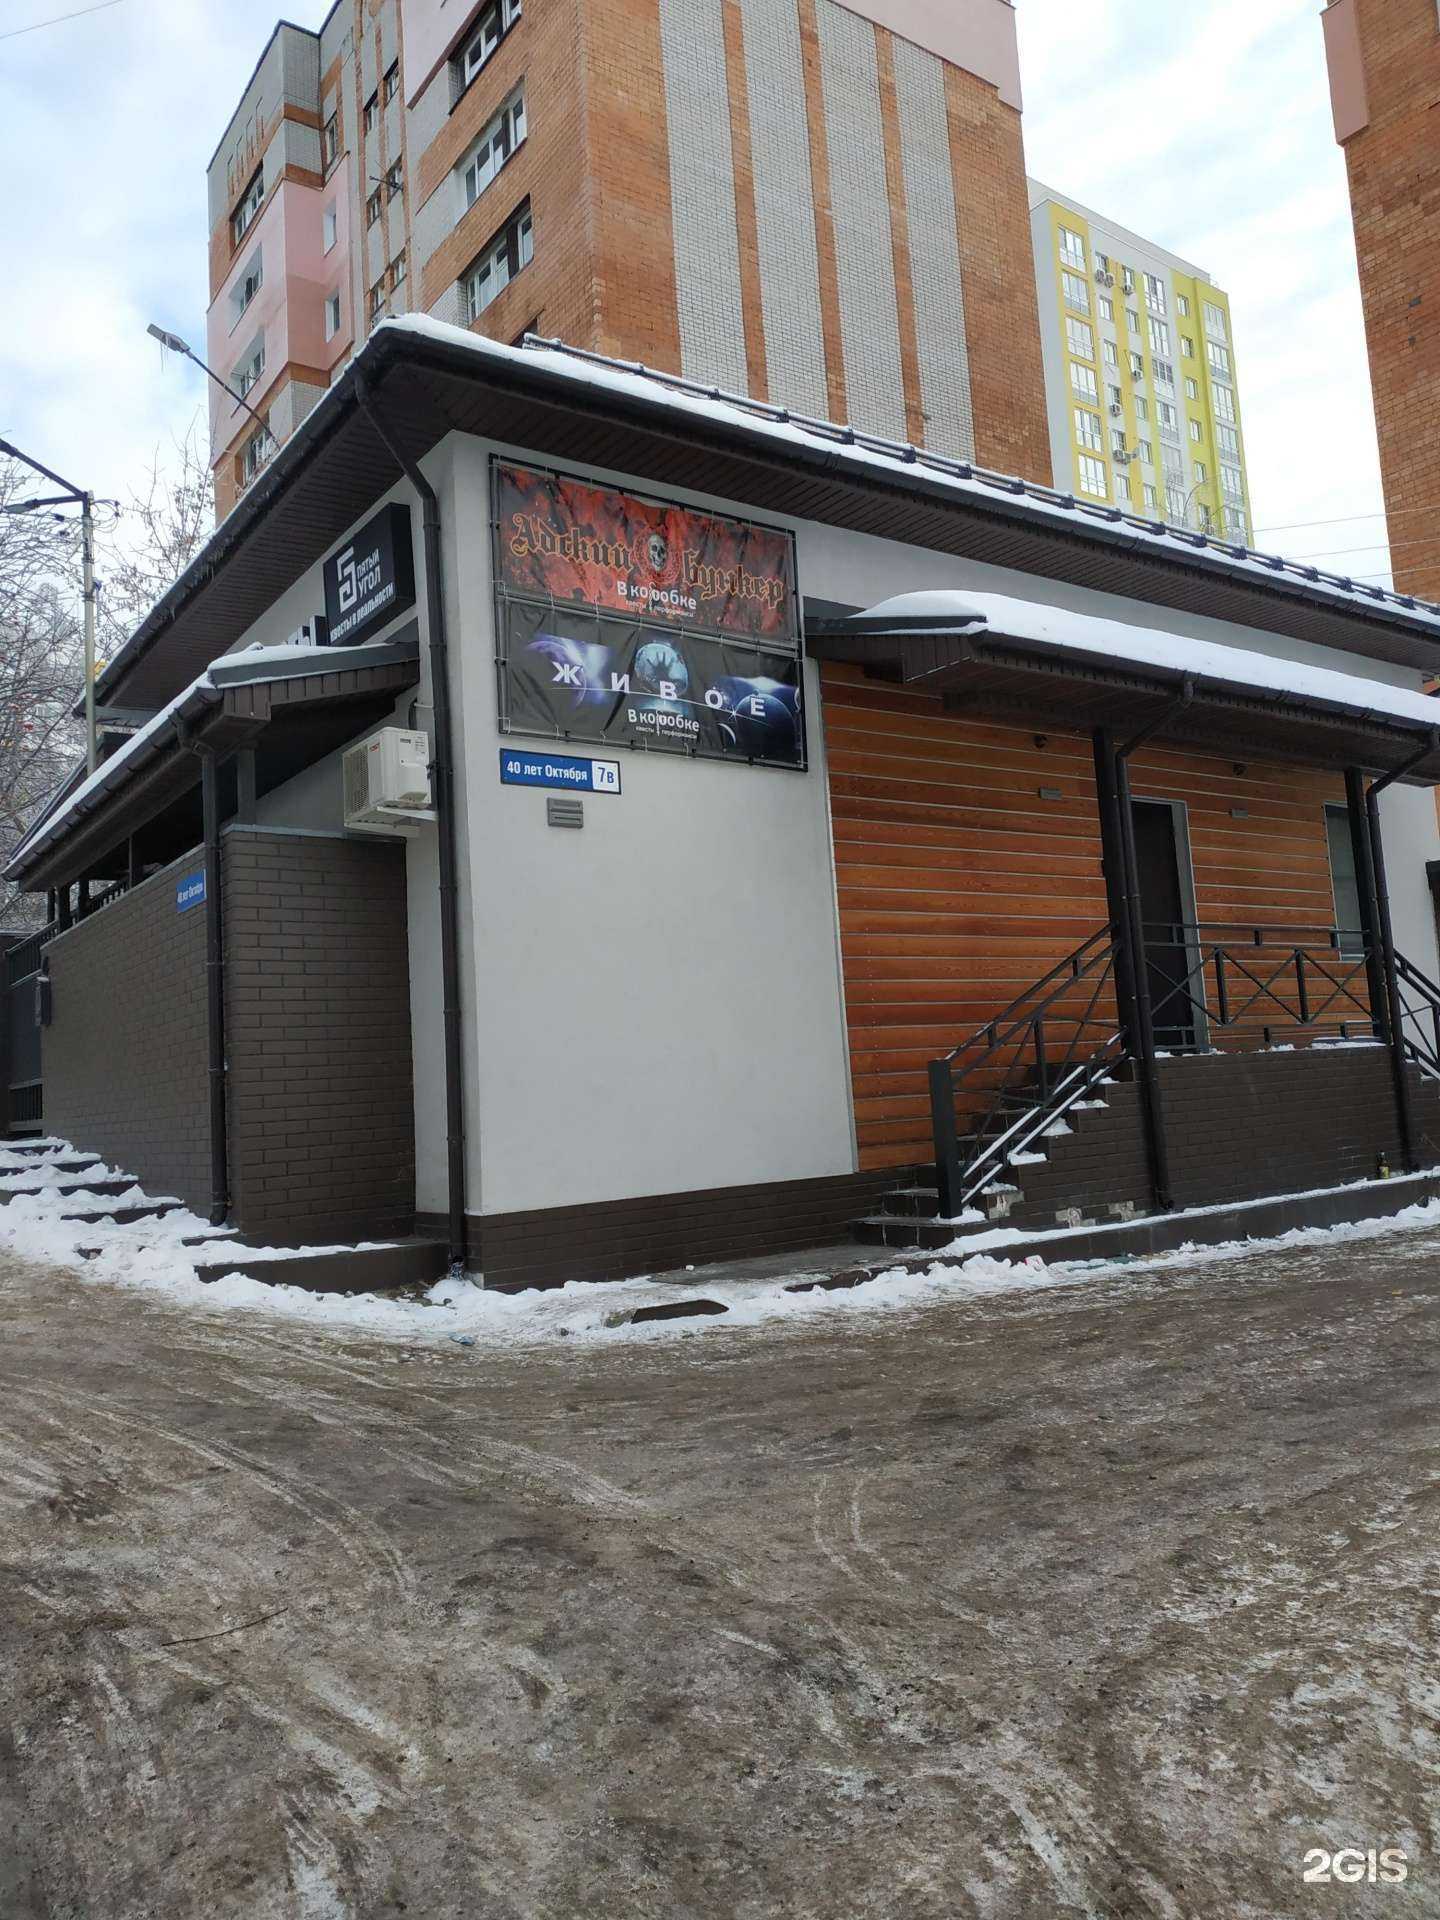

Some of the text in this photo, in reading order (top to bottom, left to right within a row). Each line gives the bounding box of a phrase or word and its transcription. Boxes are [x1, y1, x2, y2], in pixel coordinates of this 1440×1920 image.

[358, 565, 380, 598] УГОЛ
[617, 581, 627, 596] В
[630, 582, 697, 609] коробке
[628, 709, 699, 732] В коробке
[507, 761, 588, 782] 40 лет Октября
